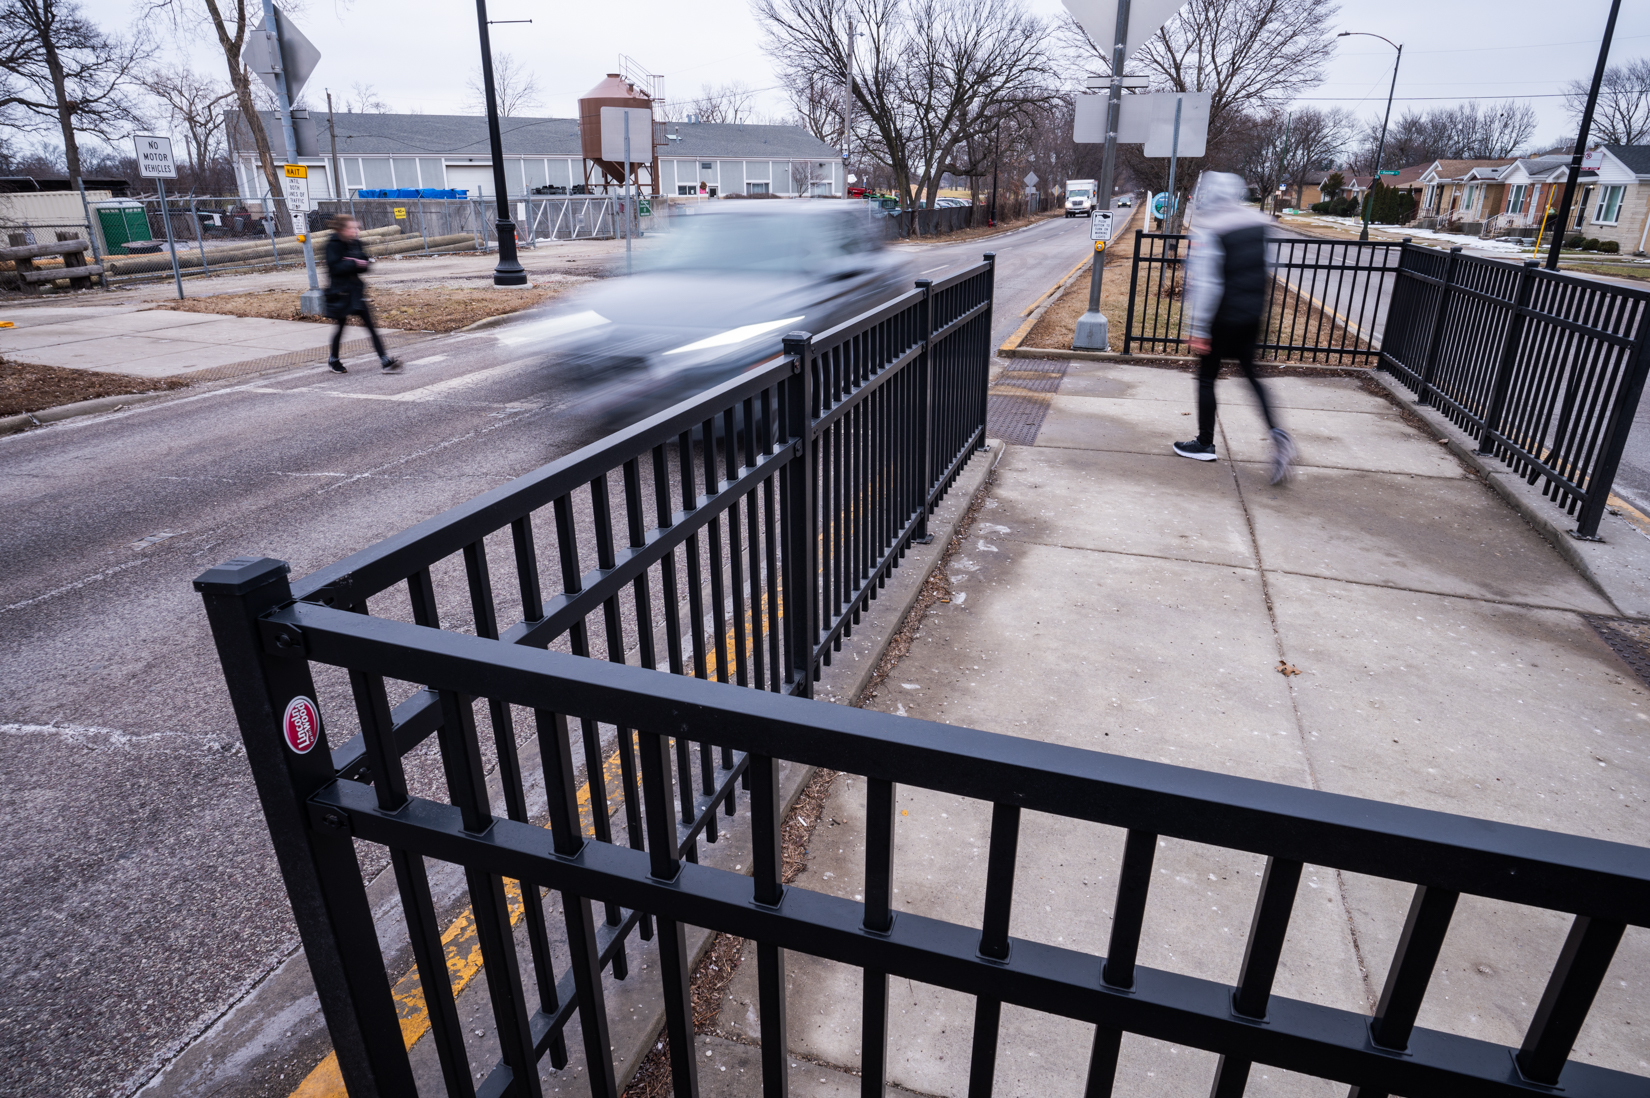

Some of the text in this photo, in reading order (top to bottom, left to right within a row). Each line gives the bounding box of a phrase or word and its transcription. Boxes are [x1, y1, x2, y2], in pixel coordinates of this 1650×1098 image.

[148, 140, 159, 150] NO
[143, 152, 169, 162] MOTOR
[143, 164, 172, 173] VEHICLES
[294, 701, 311, 732] wood
[291, 708, 310, 749] Lincoln
